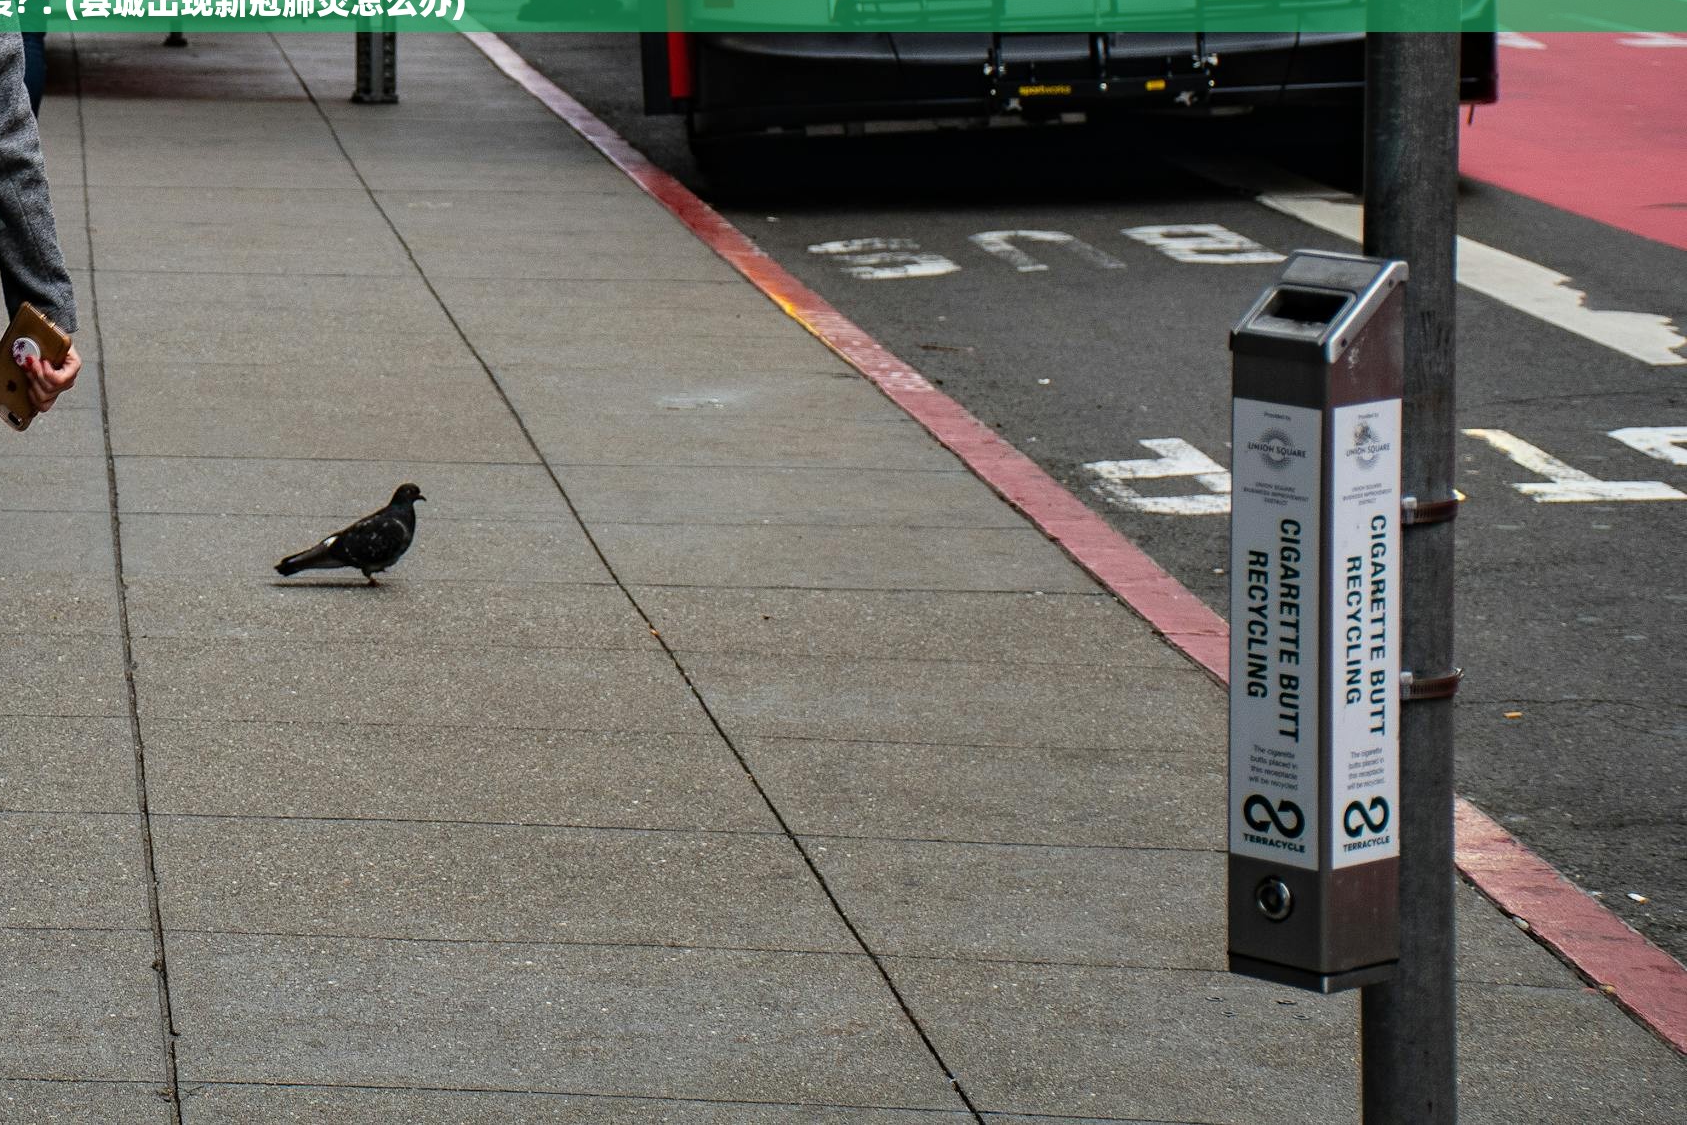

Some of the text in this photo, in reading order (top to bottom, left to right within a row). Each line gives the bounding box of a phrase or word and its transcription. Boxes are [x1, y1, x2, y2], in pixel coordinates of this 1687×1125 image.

[1247, 550, 1269, 698] RECYCLING
[1279, 518, 1301, 743] CIGARETTE BUTT
[1346, 556, 1362, 705] RECYCLING
[1369, 515, 1386, 735] CIGARETTE BUTT
[1243, 833, 1306, 853] TERRACYCLE
[1343, 836, 1390, 853] TERRACYCLE
